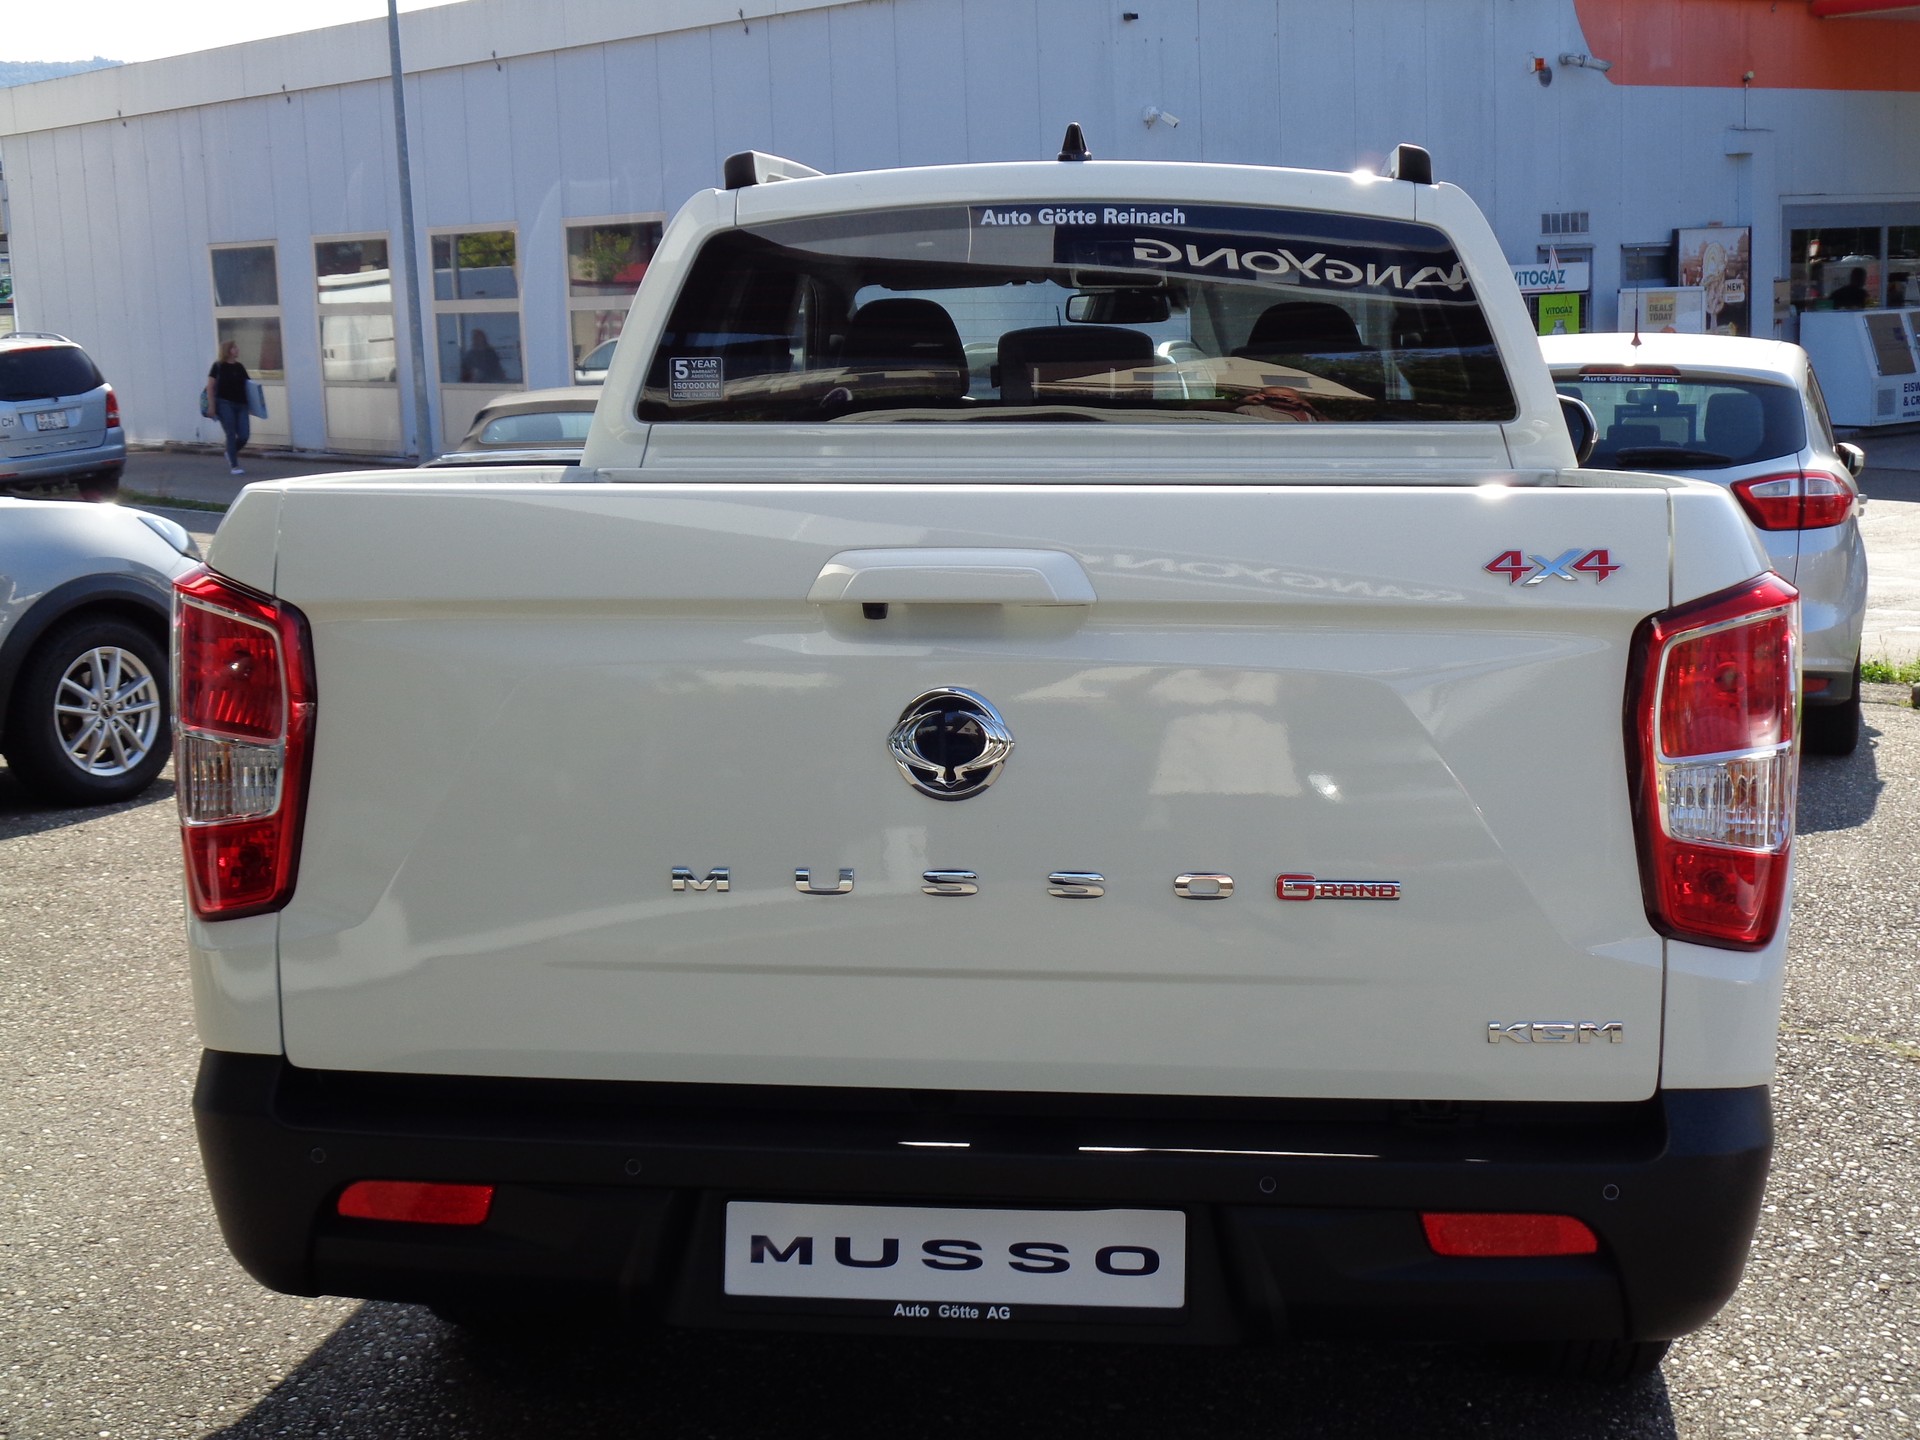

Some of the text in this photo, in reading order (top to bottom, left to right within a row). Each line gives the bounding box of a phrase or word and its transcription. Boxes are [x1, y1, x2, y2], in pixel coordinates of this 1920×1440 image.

[980, 208, 1186, 226] Auto Götte Reinach
[1727, 282, 1742, 291] NEW
[1649, 303, 1673, 312] DEALS
[1649, 312, 1673, 321] TODAY
[674, 360, 717, 379] 5 YEAR
[673, 382, 705, 390] 150'000
[2, 417, 15, 427] CH
[671, 866, 1235, 900] MUSSO
[1487, 1020, 1623, 1044] KGM
[750, 1234, 1160, 1276] MUSSO
[893, 1303, 1011, 1320] Auto Götte AG
